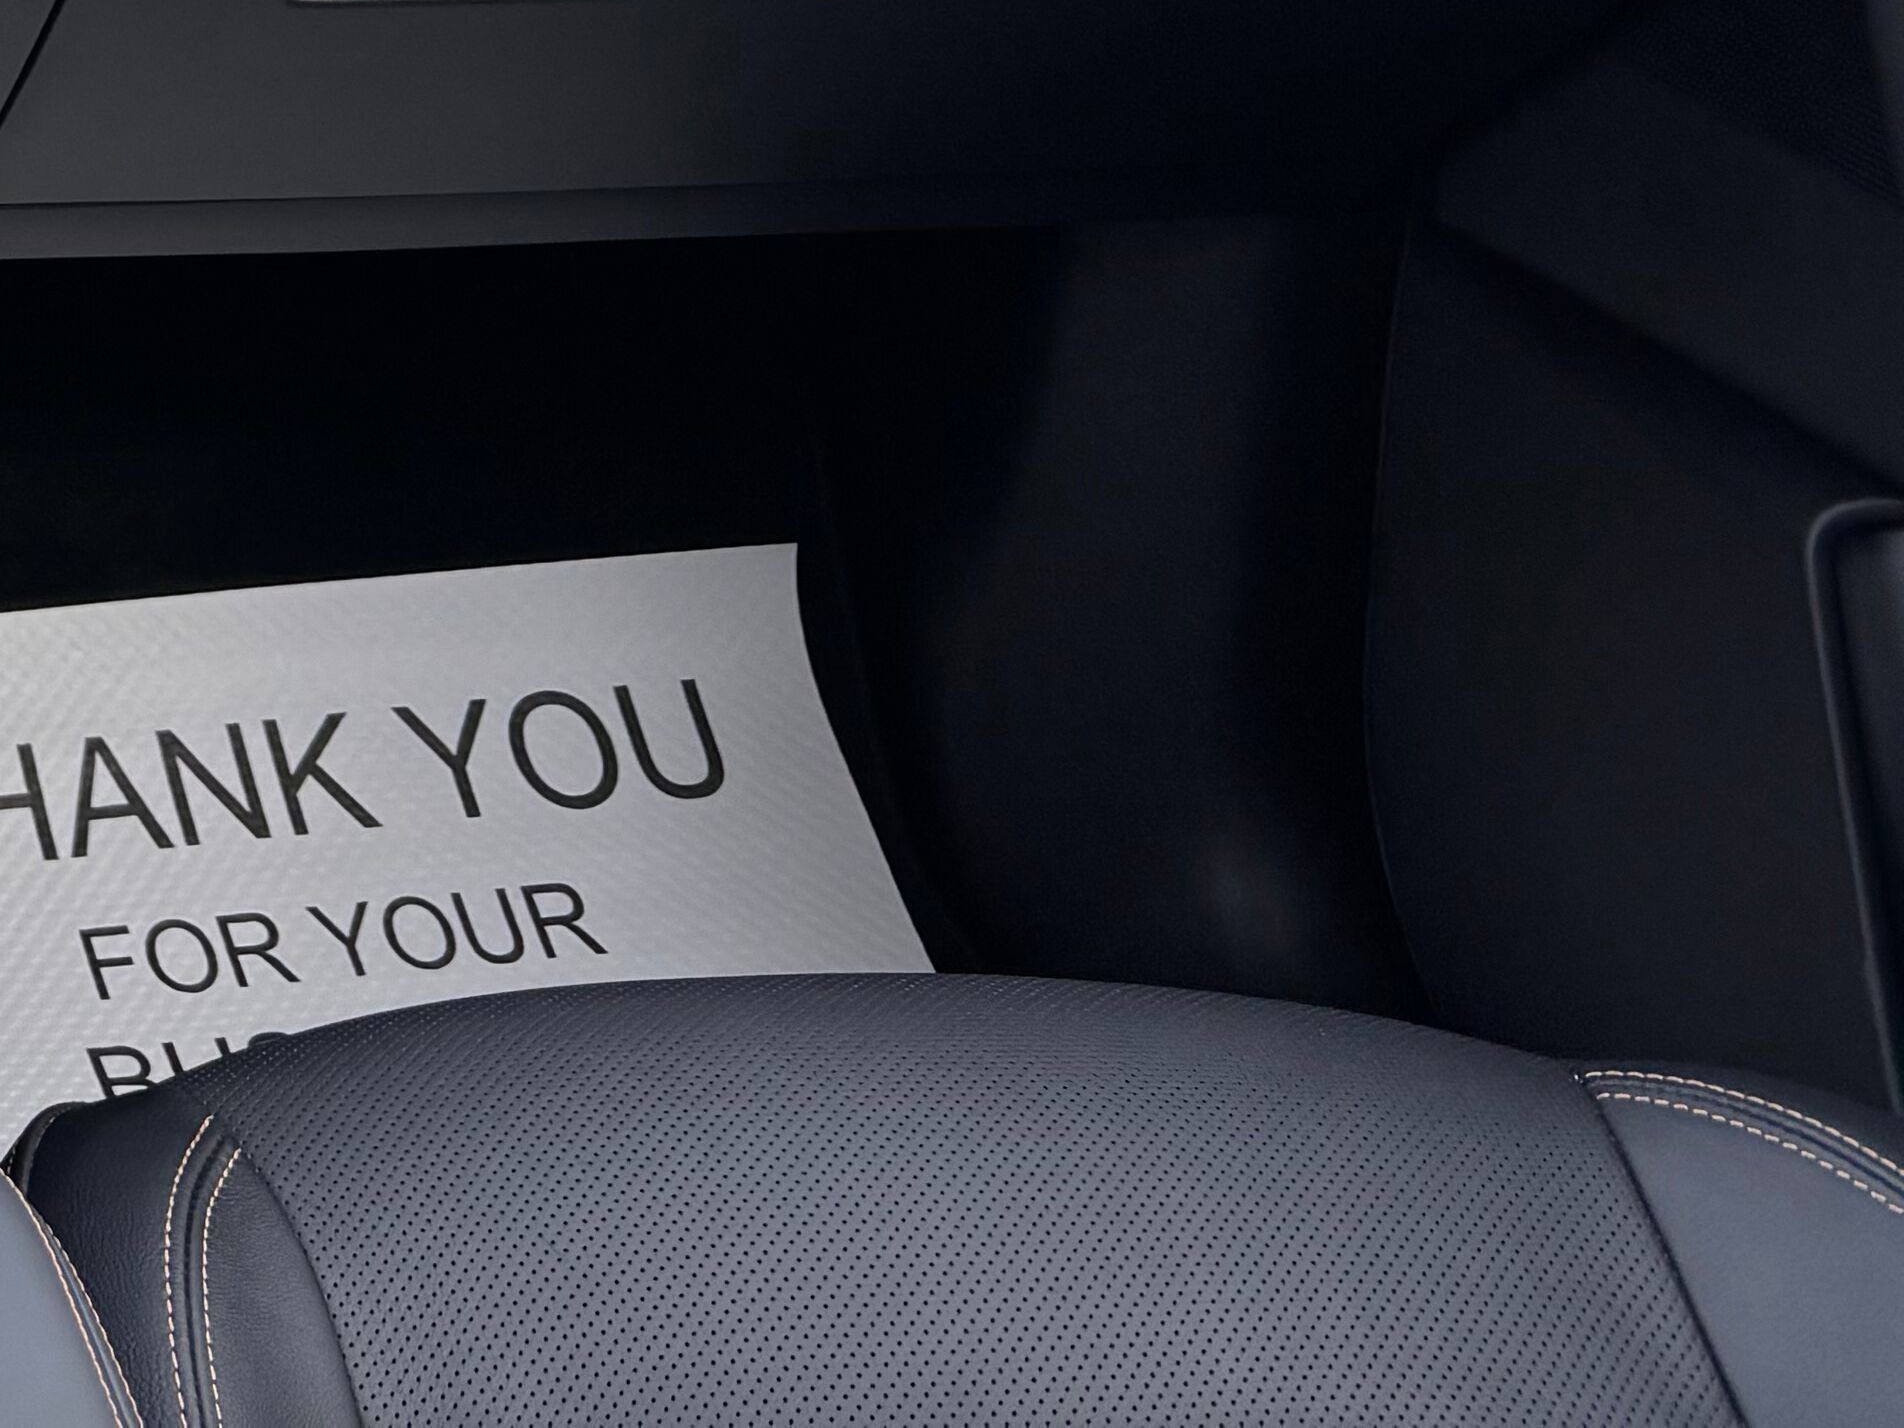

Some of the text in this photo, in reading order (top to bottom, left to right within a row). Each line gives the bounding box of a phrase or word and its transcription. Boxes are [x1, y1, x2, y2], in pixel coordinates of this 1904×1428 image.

[392, 677, 726, 819] YOU
[78, 880, 609, 1001] FOR YOUR
